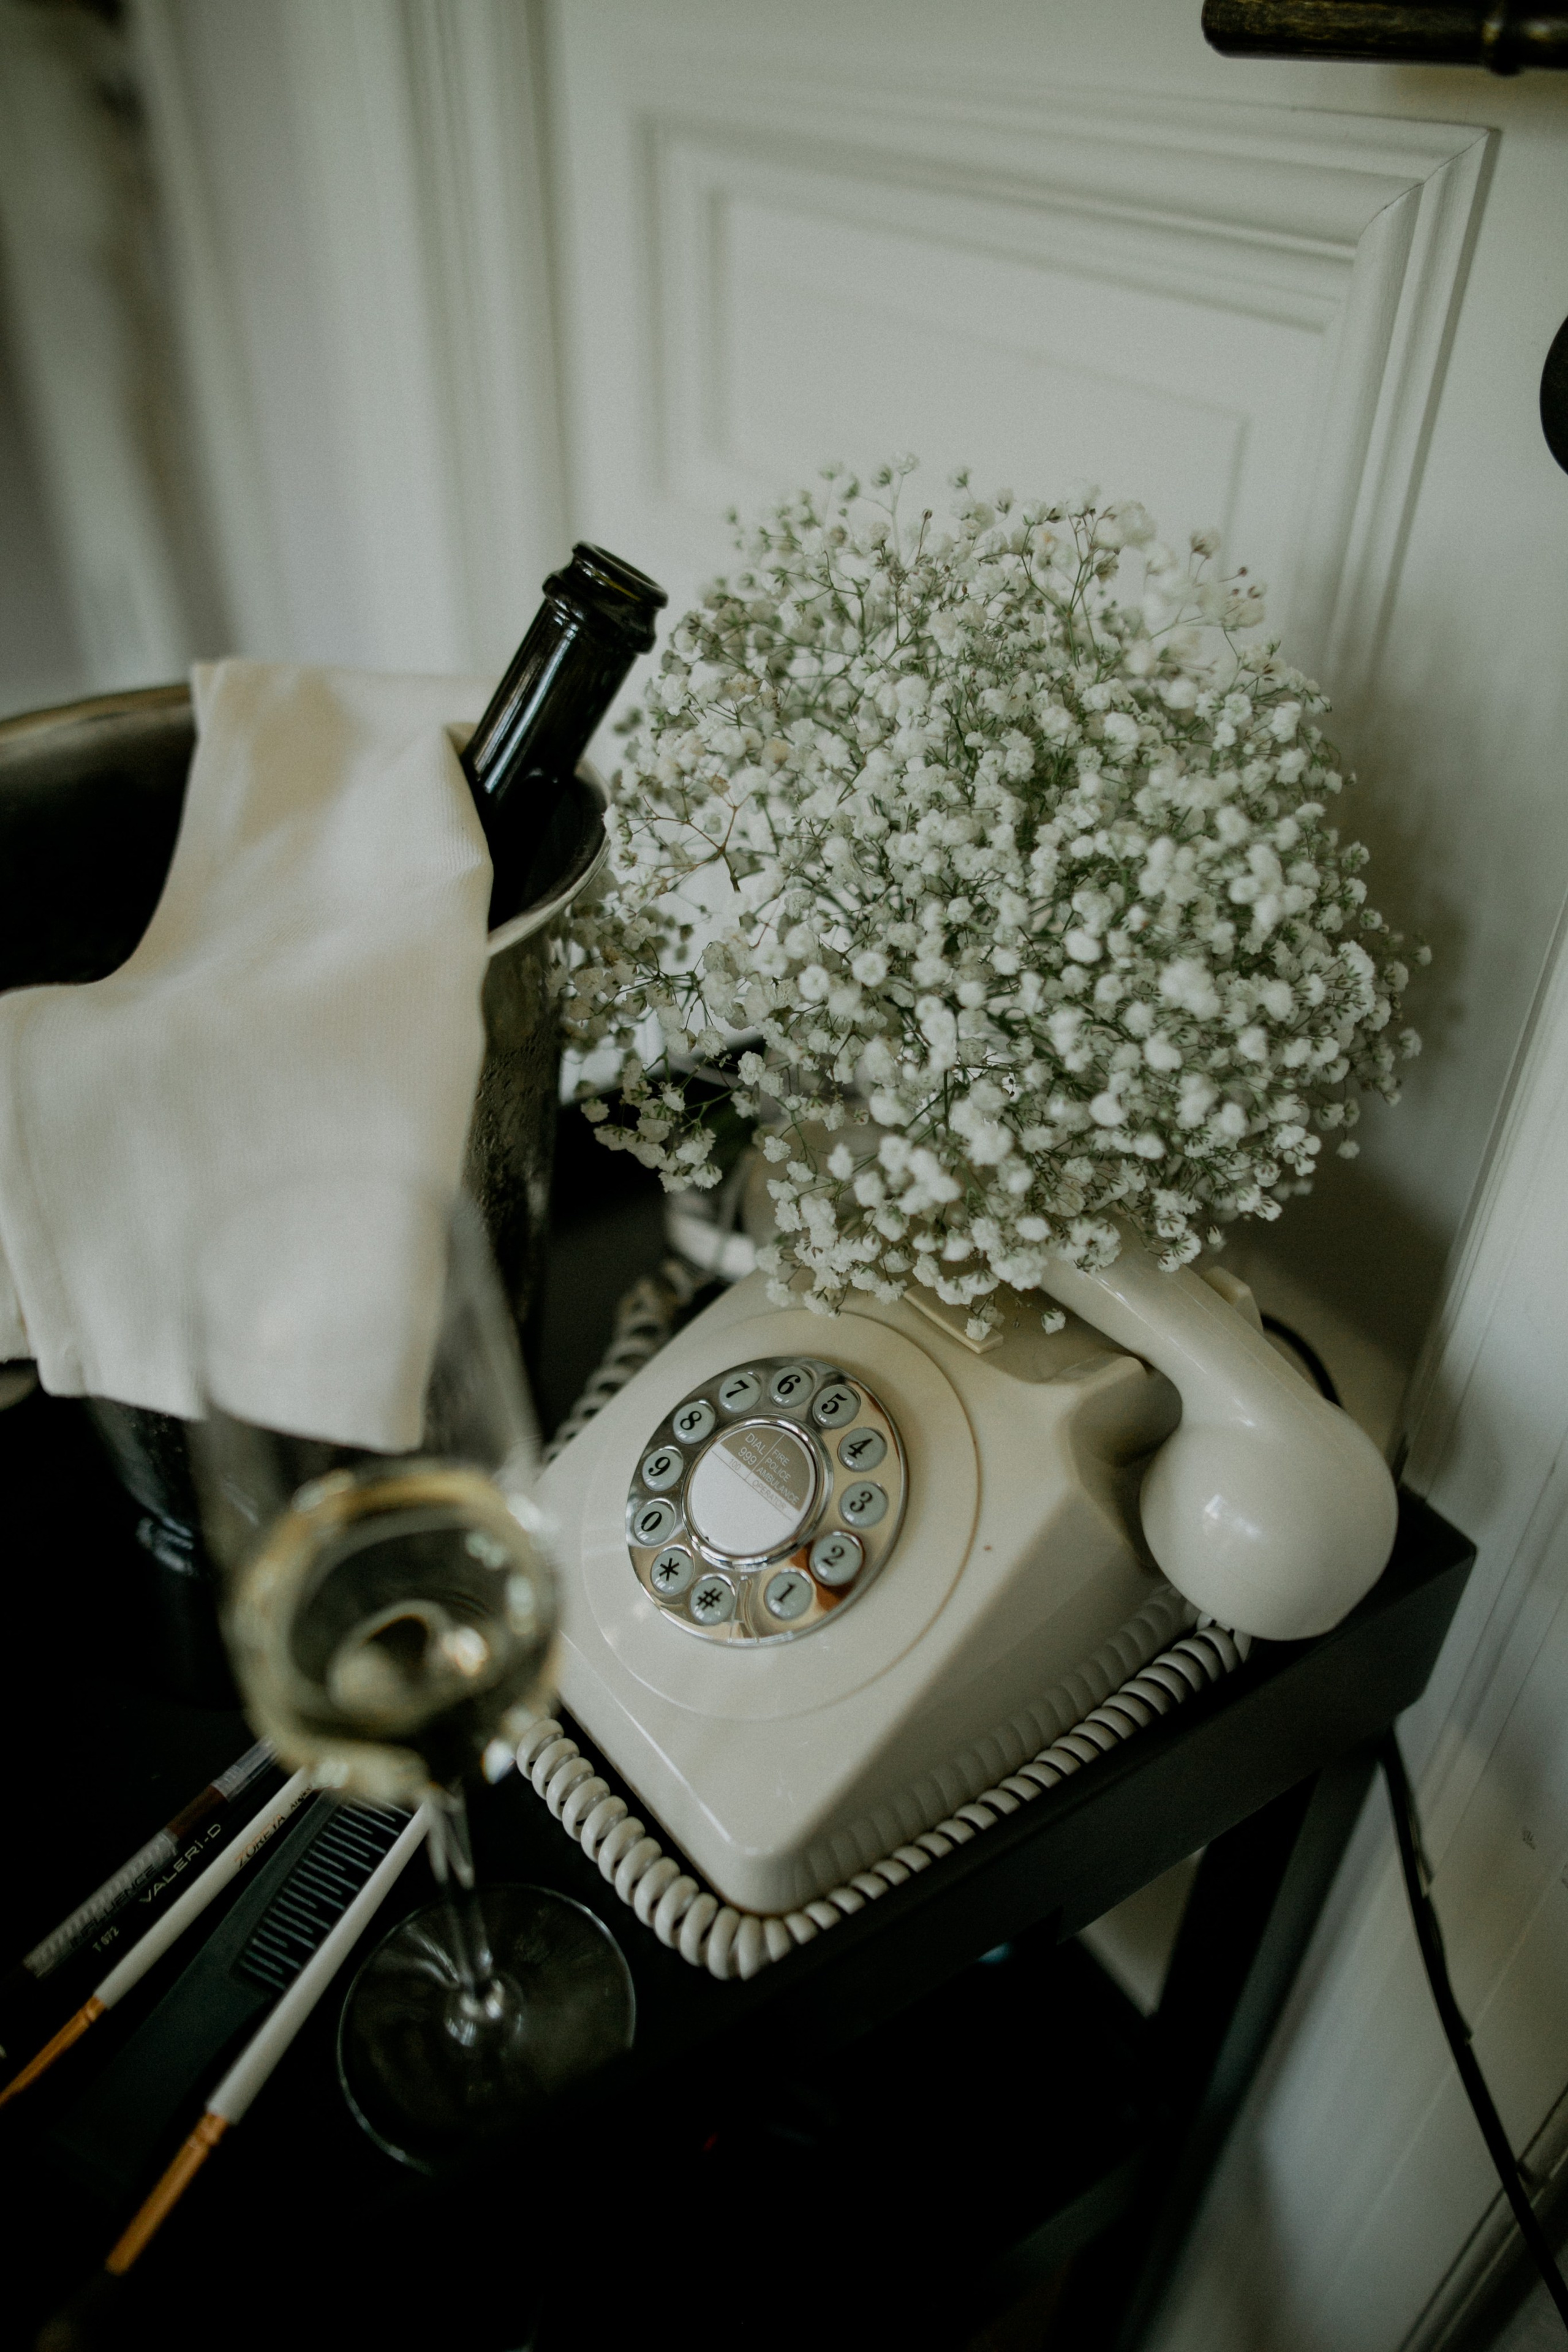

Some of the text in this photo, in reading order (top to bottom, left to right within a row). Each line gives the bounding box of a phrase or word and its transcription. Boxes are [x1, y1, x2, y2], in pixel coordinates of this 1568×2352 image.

[725, 1379, 750, 1399] 7
[777, 1374, 801, 1395] 6
[821, 1392, 848, 1415] 5
[679, 1410, 703, 1431] 8
[745, 1433, 766, 1455] DIAL
[847, 1438, 873, 1460] 4
[648, 1456, 671, 1477] 9
[728, 1458, 742, 1471] 100
[737, 1447, 757, 1466] 999
[772, 1449, 790, 1466] FIRE
[764, 1457, 791, 1482] POLICE
[752, 1479, 788, 1510] OPERATOR
[756, 1467, 800, 1506] AMBULANCE
[849, 1490, 873, 1513] 3
[641, 1510, 663, 1532] 0
[821, 1545, 846, 1567] 2
[775, 1582, 796, 1604] 1
[235, 1814, 286, 1868] ZOREYA
